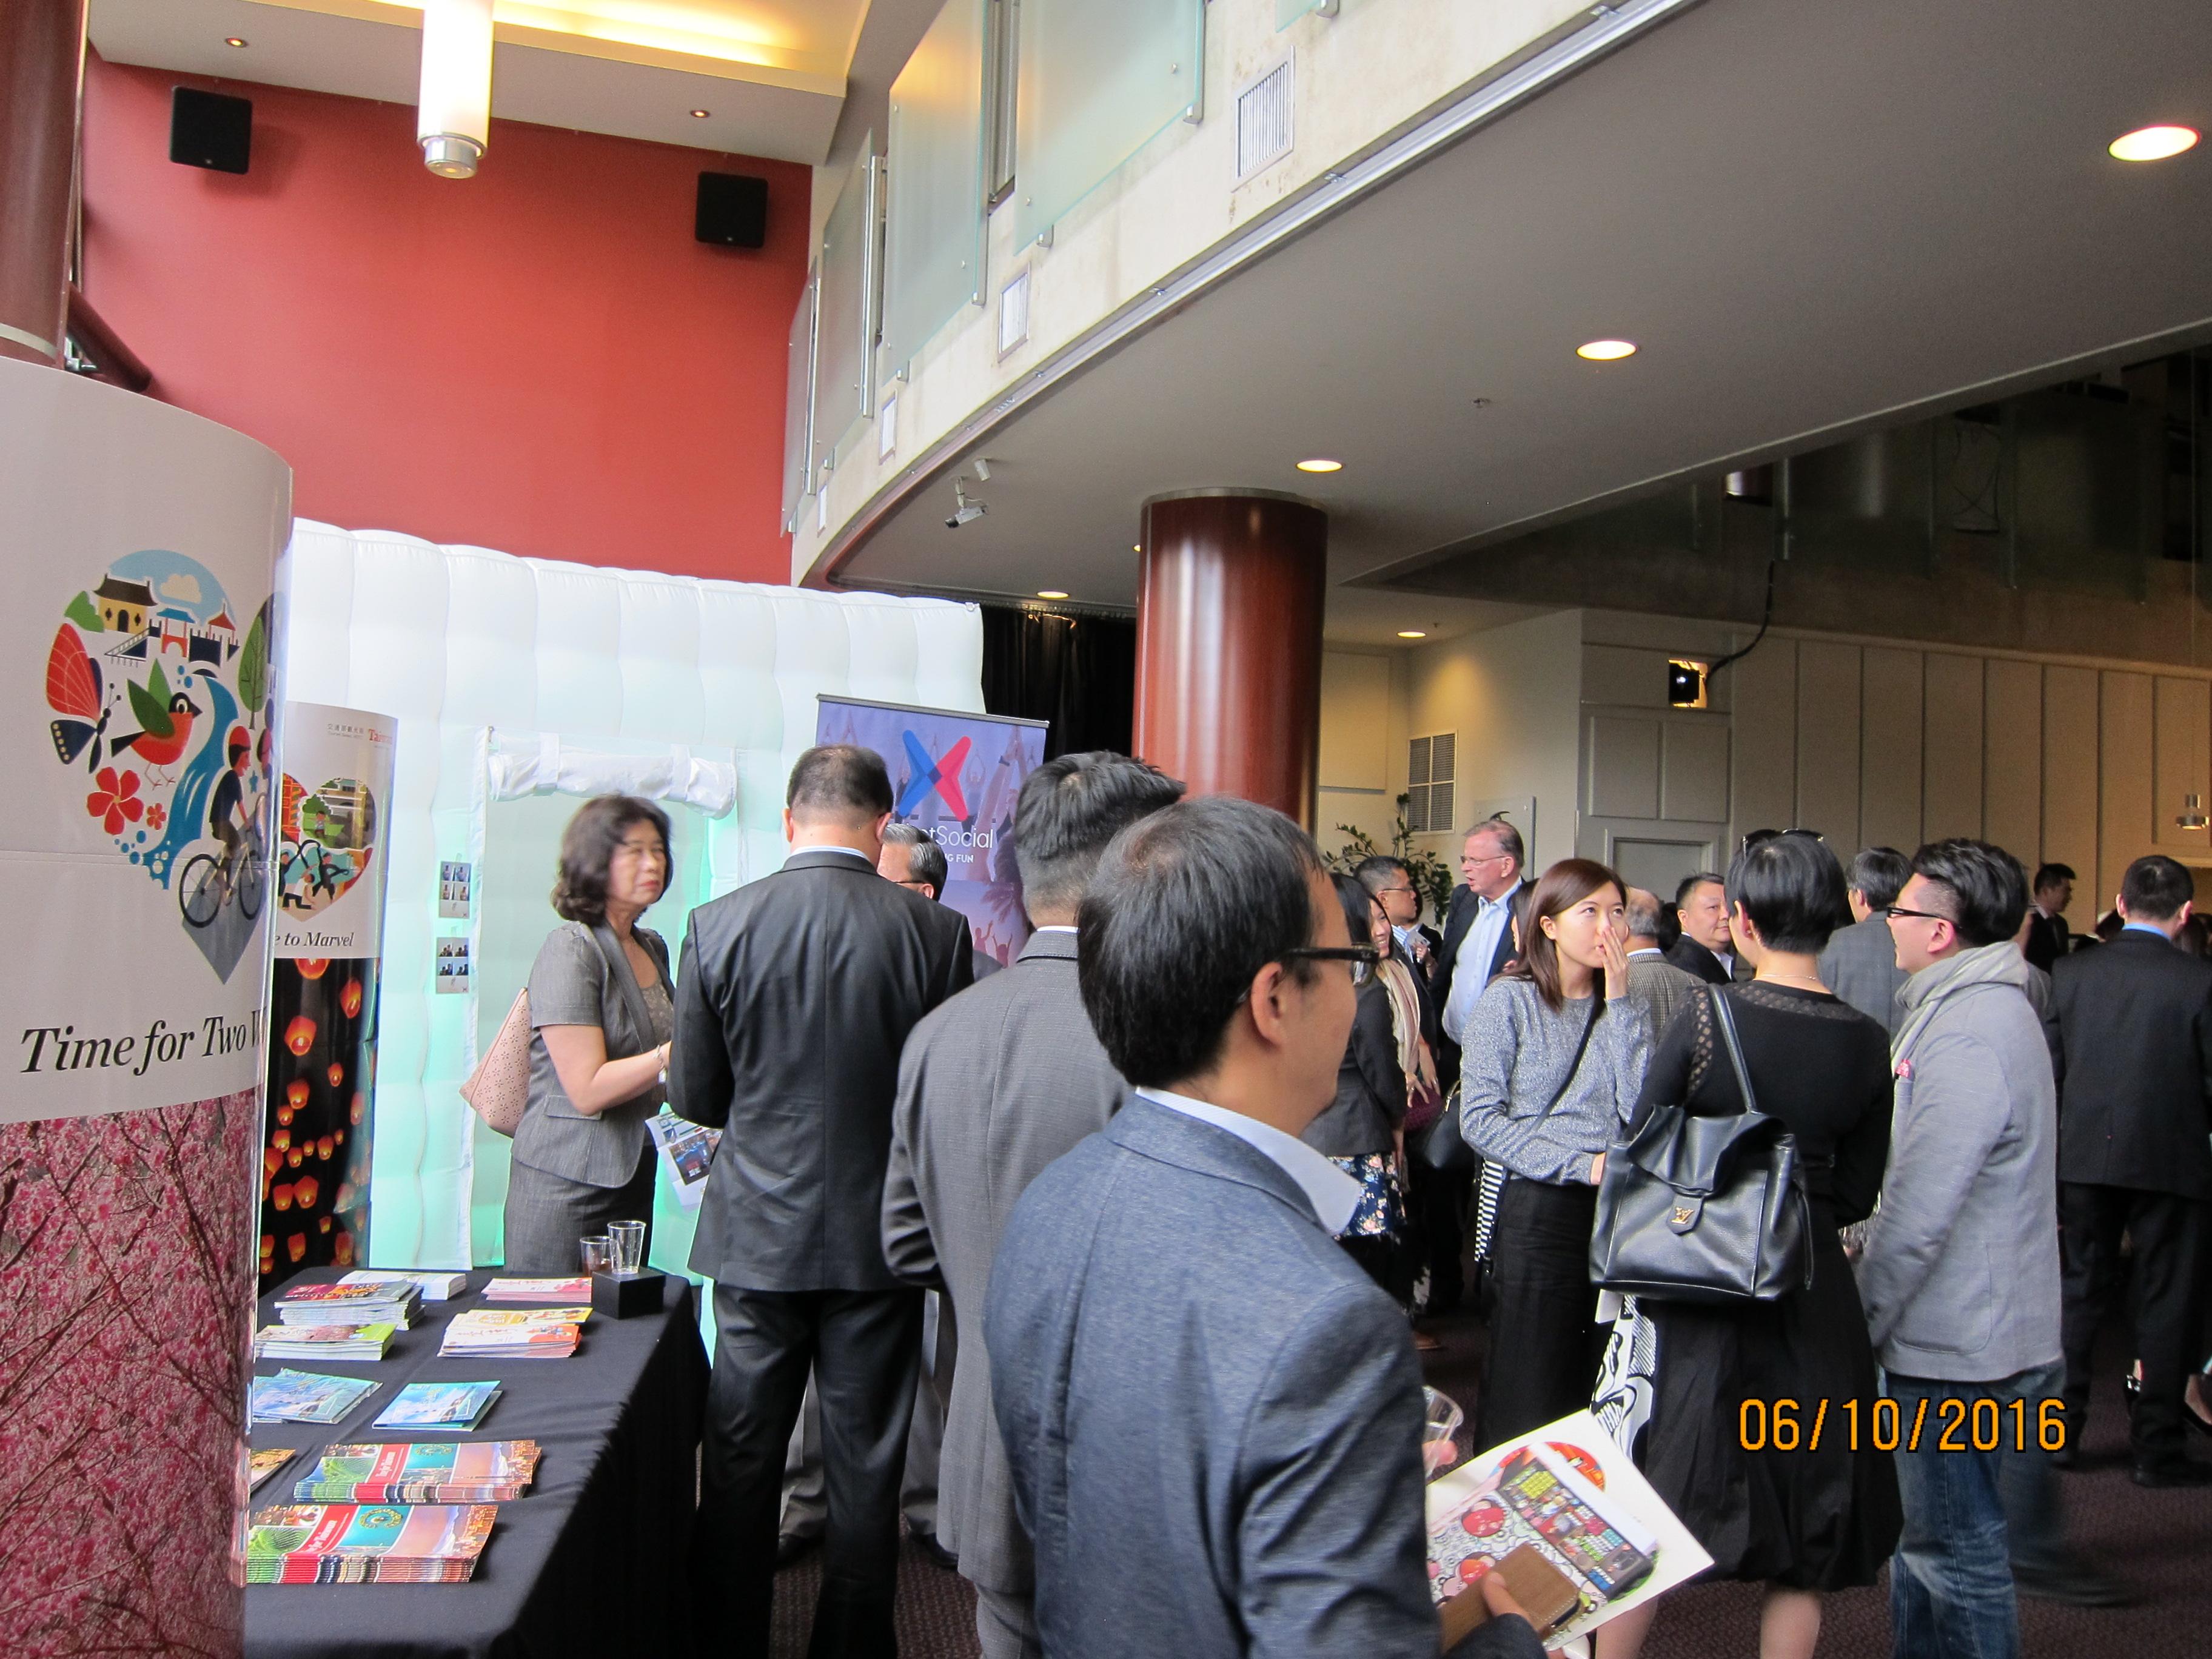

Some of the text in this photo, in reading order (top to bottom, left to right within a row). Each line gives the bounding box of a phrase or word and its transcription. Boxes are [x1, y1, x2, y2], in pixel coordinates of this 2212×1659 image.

[907, 823, 993, 848] tSocial
[956, 854, 974, 863] FUN
[284, 933, 300, 946] to
[303, 931, 354, 947] Marvel
[20, 1025, 135, 1073] Time
[133, 1019, 195, 1076] for
[201, 1015, 246, 1057] Two
